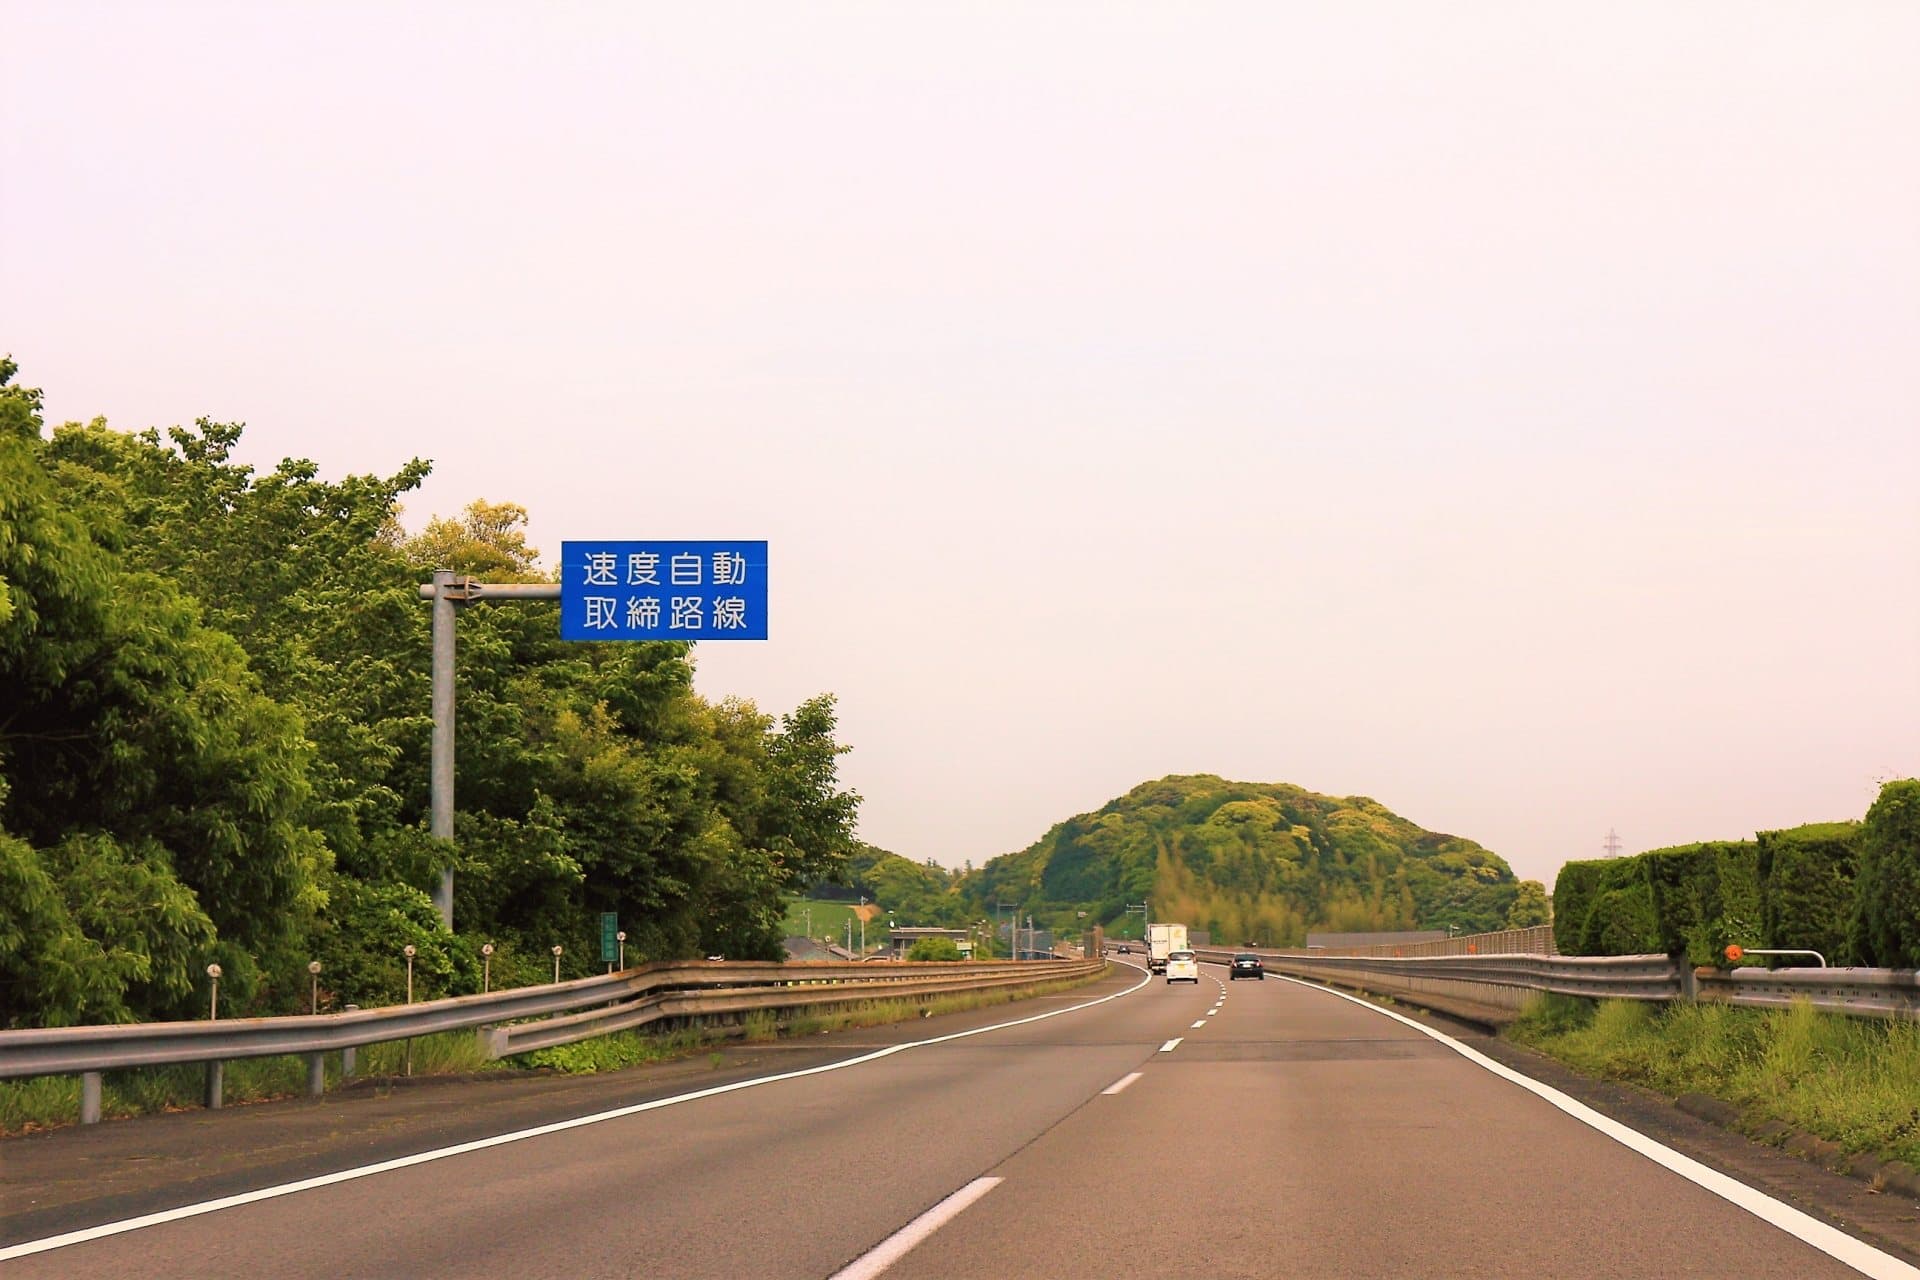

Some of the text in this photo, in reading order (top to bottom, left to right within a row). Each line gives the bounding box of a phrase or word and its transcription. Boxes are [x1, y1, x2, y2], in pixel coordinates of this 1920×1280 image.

[583, 551, 746, 586] 速度自動
[583, 596, 747, 630] 取締路線
